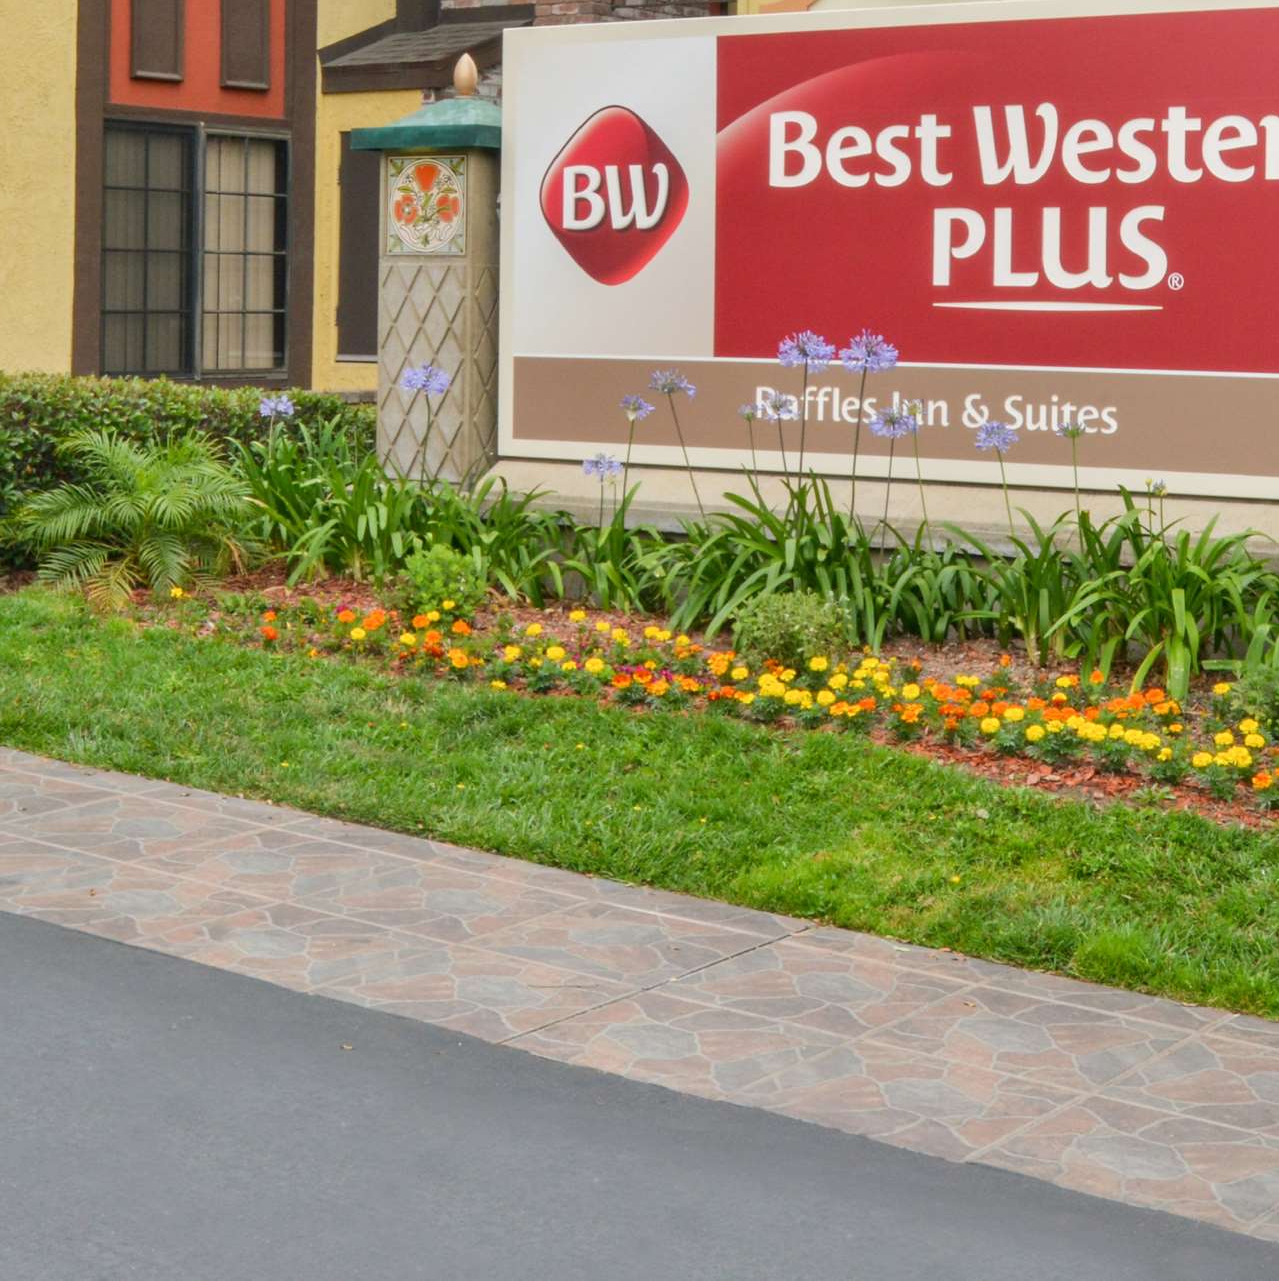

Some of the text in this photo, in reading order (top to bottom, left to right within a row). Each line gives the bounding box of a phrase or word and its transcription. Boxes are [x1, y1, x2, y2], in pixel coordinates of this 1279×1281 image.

[768, 110, 953, 188] Best
[562, 162, 669, 230] BW
[755, 385, 878, 424] Raffles
[961, 393, 990, 429] &
[1003, 394, 1119, 435] Suites
